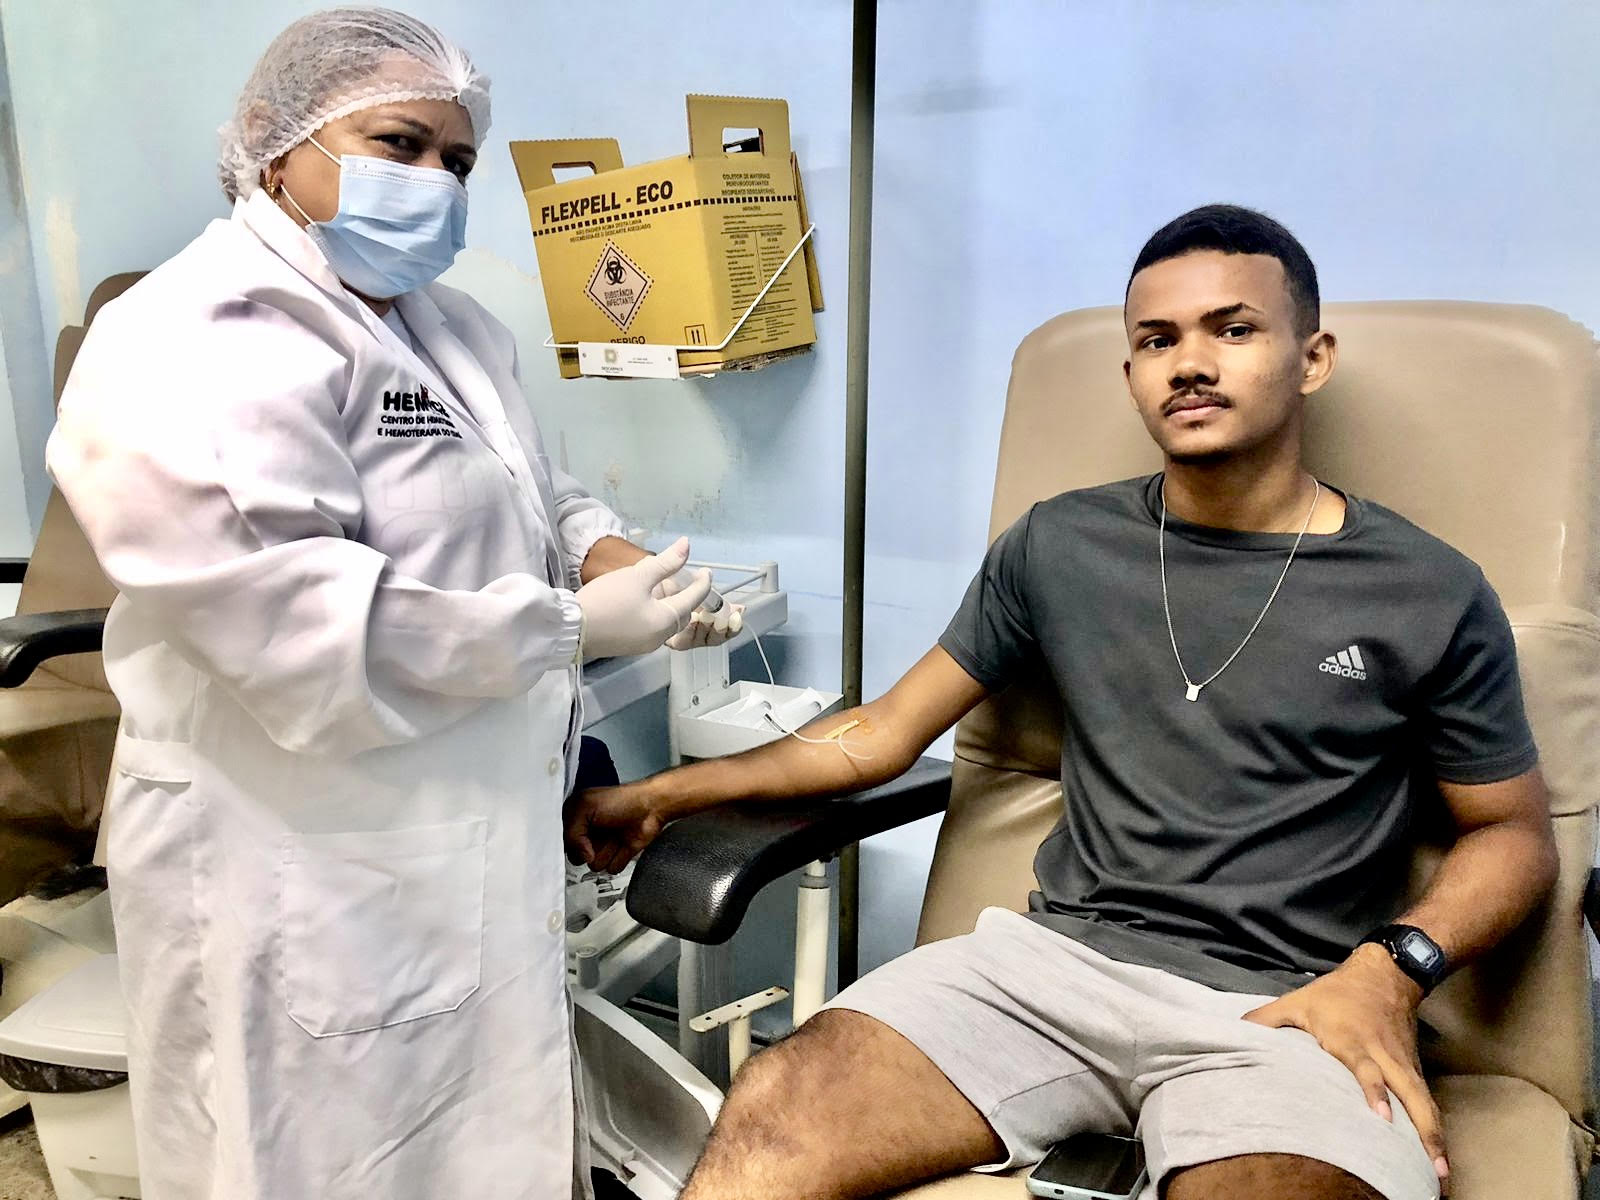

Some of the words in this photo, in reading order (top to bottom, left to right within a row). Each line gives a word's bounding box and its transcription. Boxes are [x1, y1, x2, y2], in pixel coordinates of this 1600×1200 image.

[541, 192, 621, 225] FLEXPELL
[636, 180, 673, 205] ECO
[604, 288, 634, 300] SUBSTÂNCIA
[380, 415, 415, 425] CENTRO
[415, 415, 426, 425] DE
[377, 427, 383, 436] E
[385, 428, 442, 438] HEMOTERAPIA
[1318, 662, 1367, 681] adidas
